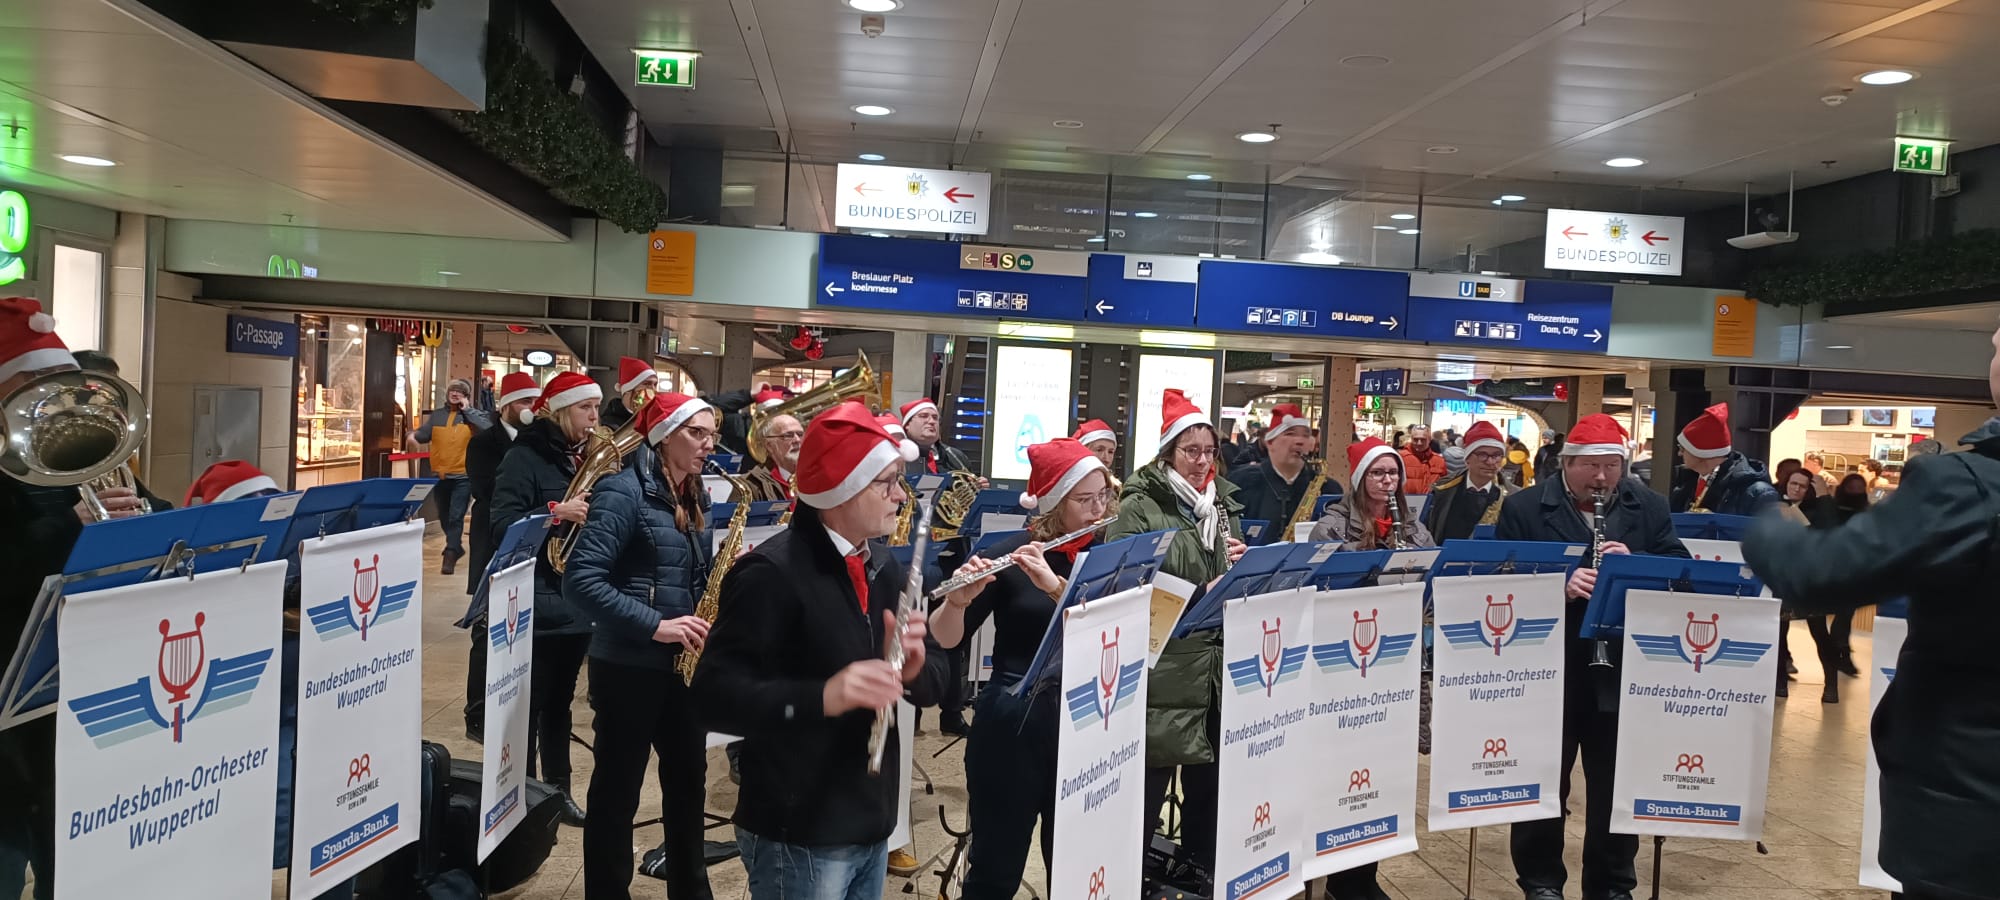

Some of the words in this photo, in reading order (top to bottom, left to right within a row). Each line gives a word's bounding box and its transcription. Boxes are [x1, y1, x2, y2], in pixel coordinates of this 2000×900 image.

[848, 205, 977, 225] BUNDESPOLIZEI
[1557, 248, 1671, 266] BUNDESPOLIZEI
[851, 271, 891, 284] Breslauer
[893, 274, 914, 284] Platz
[851, 283, 898, 294] koelnmesse
[1461, 282, 1472, 296] U
[959, 297, 971, 305] WC
[1331, 311, 1343, 321] DB
[1345, 312, 1375, 324] Lounge
[1527, 313, 1579, 324] Reisezentrum
[236, 322, 284, 349] C-Passage
[1540, 324, 1561, 335] Dom,
[1562, 326, 1578, 337] City
[306, 648, 414, 699] Bundesbahn-Orchester
[1439, 668, 1557, 688] Bundesbahn-Orchester
[337, 674, 388, 709] Wuppertal
[1469, 684, 1526, 702] Wuppertal
[1628, 683, 1767, 704] Bundesbahn-Orchester
[1308, 688, 1415, 716] Bundesbahn-Orchester
[1664, 700, 1729, 717] Wuppertal
[1224, 707, 1306, 746] Bundesbahn-Orchester
[1338, 707, 1388, 730] Wuppertal
[1247, 731, 1286, 759] Wuppertal
[1060, 739, 1140, 801] Bundesbahn-Orchester
[1471, 760, 1518, 770] STIFTUNGSFAMILIE
[1662, 774, 1716, 784] STIFTUNGSFAMILIE
[69, 747, 269, 840] Bundesbahn-Orchester
[336, 777, 379, 807] STIFTUNGSFAMILIE
[1083, 770, 1122, 814] Wuppertal
[1338, 790, 1379, 807] STIFTUNGSFAMILIE
[1459, 788, 1530, 806] Sparda-Bank
[129, 788, 221, 850] Wuppertal
[1646, 803, 1729, 818] Sparda-Bank
[321, 813, 389, 861] Sparda-Bank
[1326, 821, 1389, 846] Sparda-Bank
[1234, 860, 1284, 896] Sparda-Bank
